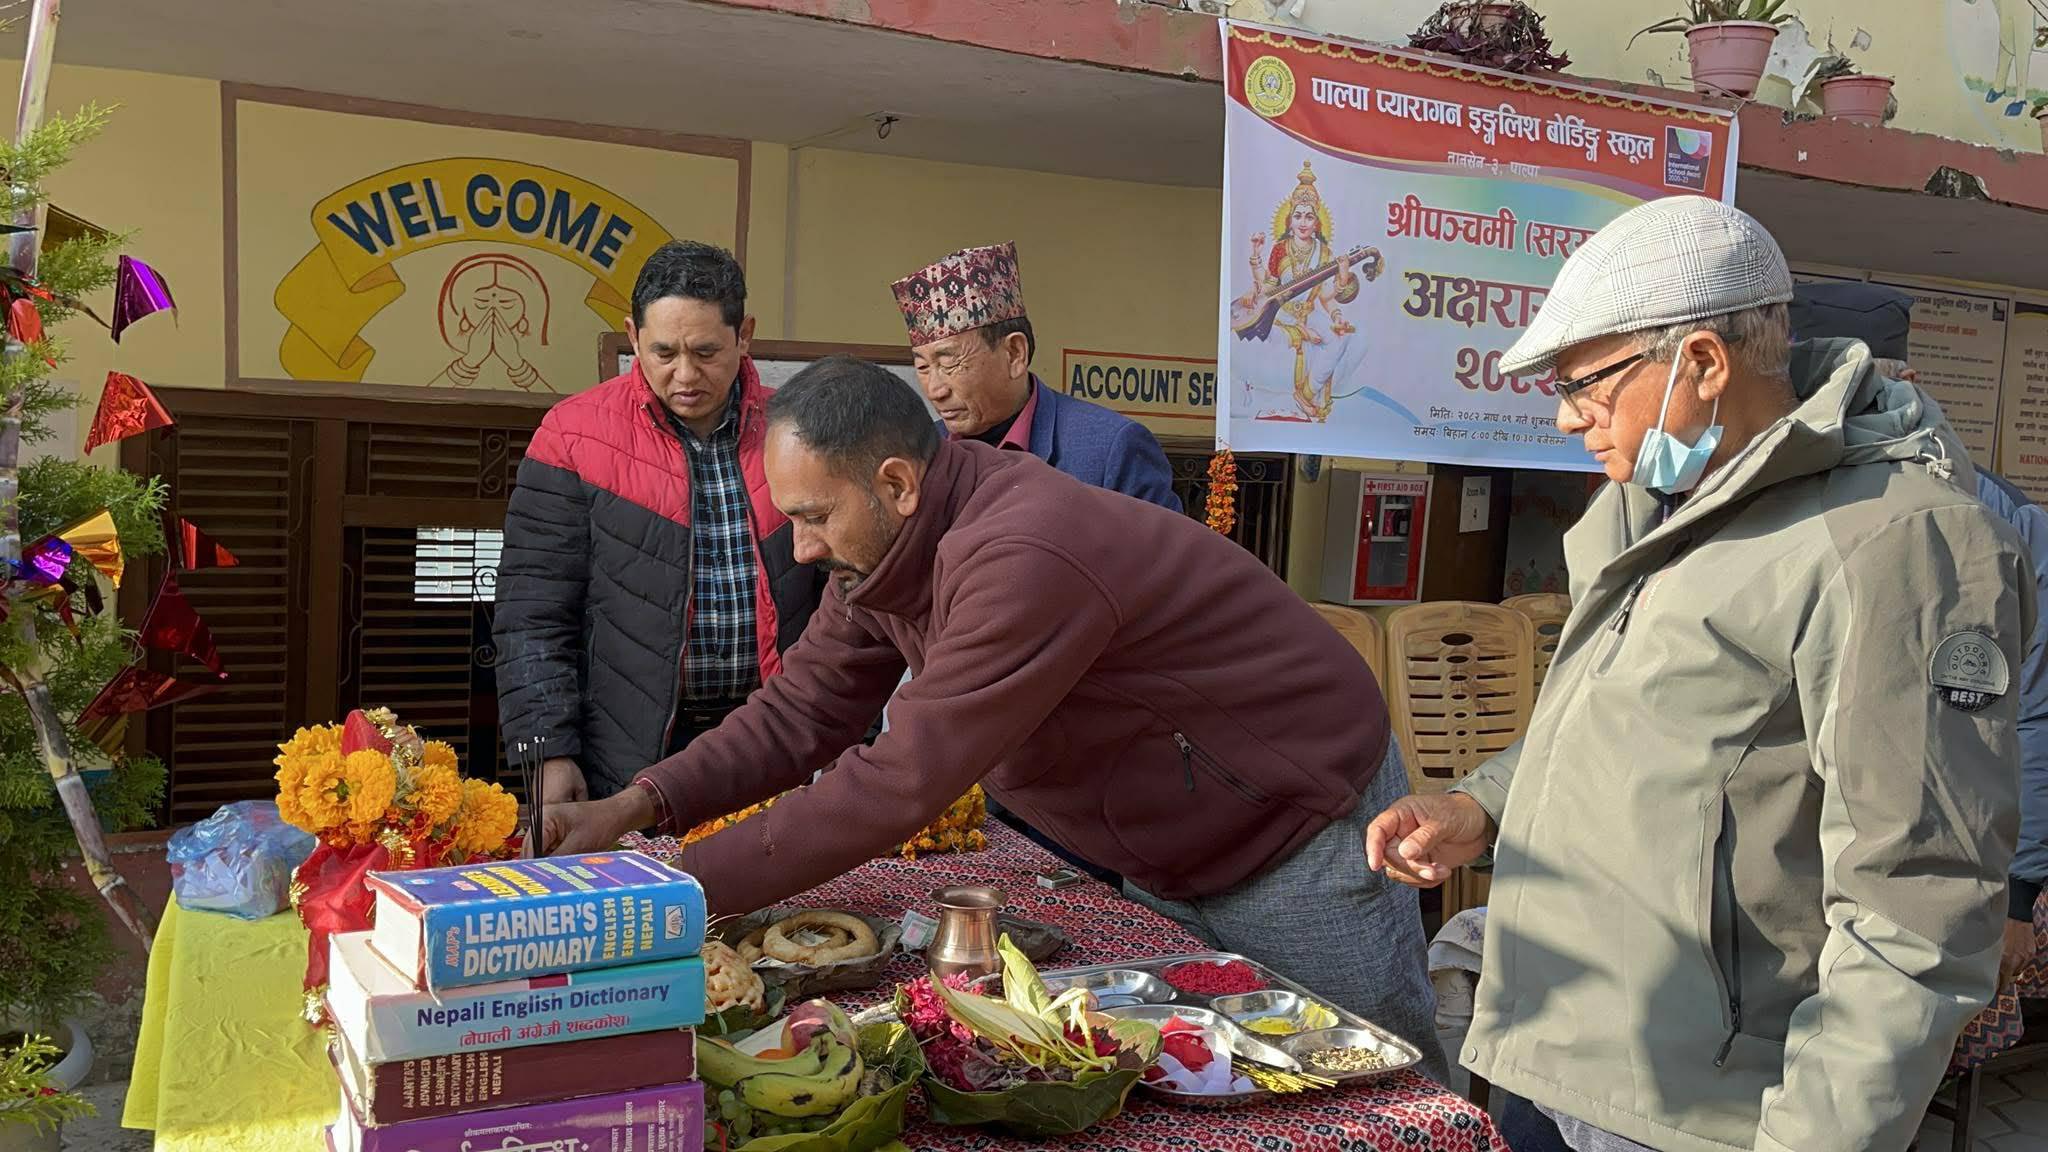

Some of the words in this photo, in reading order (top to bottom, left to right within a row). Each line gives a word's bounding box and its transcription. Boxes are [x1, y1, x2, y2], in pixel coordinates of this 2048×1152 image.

[1311, 77, 1370, 112] पाल्पा
[1376, 89, 1463, 127] प्यारागन
[1606, 130, 1655, 165] स्कूल
[1510, 161, 1540, 178] पाल्पा
[1668, 161, 1699, 171] International
[1668, 167, 1686, 176] School
[1386, 194, 1517, 251] श्रीपञ्चमी
[1403, 271, 1550, 328] अक्षरा
[1071, 364, 1183, 404] ACCOUNT
[1188, 371, 1217, 406] SE
[1377, 482, 1395, 491] FIRST
[1396, 483, 1408, 492] AID
[1410, 484, 1423, 492] BOX
[1950, 690, 1984, 703] BEST
[465, 901, 598, 945] LEARNER'S
[602, 897, 617, 960] ENGLISH
[621, 895, 634, 958] ENGLISH
[640, 898, 653, 950] NEPALI
[463, 935, 597, 977] DICTIONARY
[417, 1002, 485, 1027] Nepali
[492, 992, 563, 1020] English
[570, 983, 670, 1009] Dictionary
[420, 1059, 431, 1107] ADVANCED
[450, 1054, 461, 1107] DICTIONARY
[465, 1053, 475, 1103] ENGLISH
[479, 1051, 488, 1101] ENGLISH
[492, 1055, 502, 1095] NEPALI
